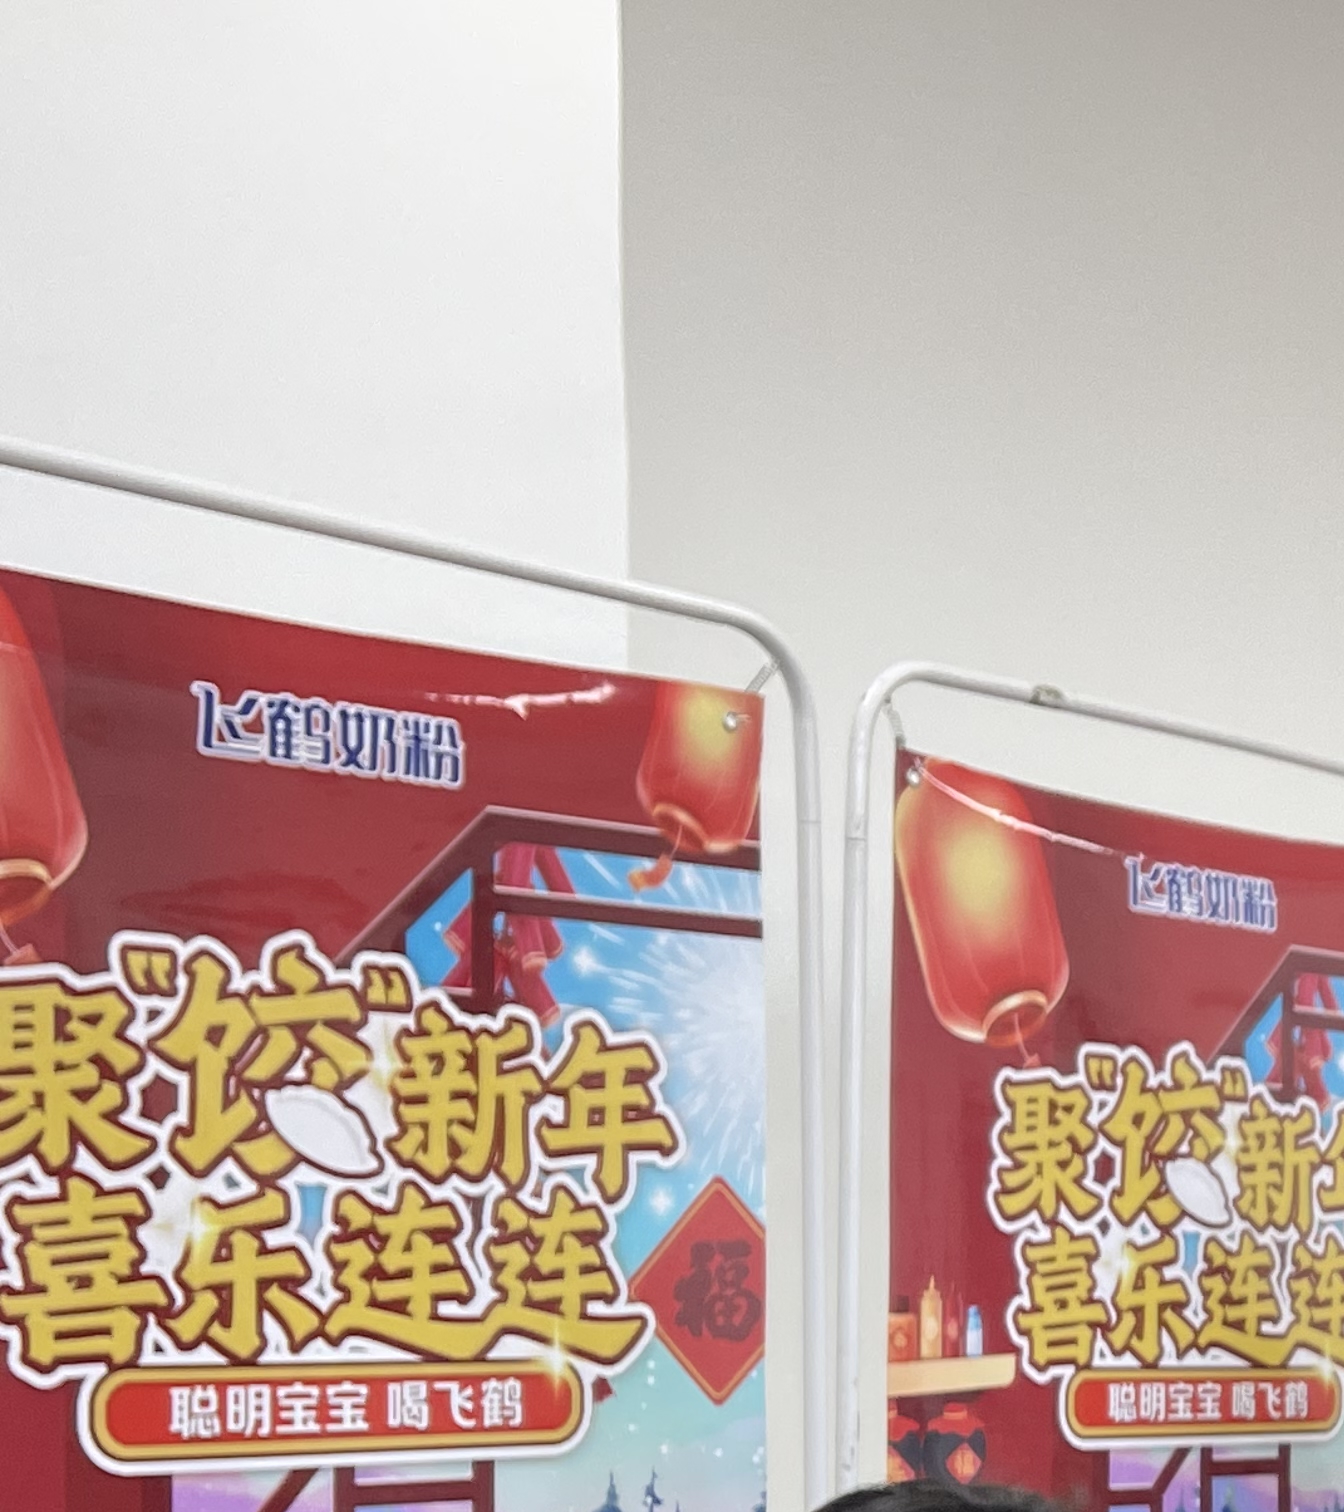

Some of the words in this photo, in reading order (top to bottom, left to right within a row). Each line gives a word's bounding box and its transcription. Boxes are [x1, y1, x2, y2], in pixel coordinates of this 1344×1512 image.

[191, 682, 465, 788] 飞鹤奶粉
[1125, 857, 1277, 932] 飞鹤奶粉
[0, 1178, 650, 1367] 喜乐连连
[674, 1239, 762, 1342] 福
[168, 1380, 371, 1439] 聪明宝宝
[386, 1376, 524, 1432] 喝飞鹤
[1107, 1381, 1223, 1423] 聪明宝宝
[1231, 1379, 1309, 1420] 喝飞鹤
